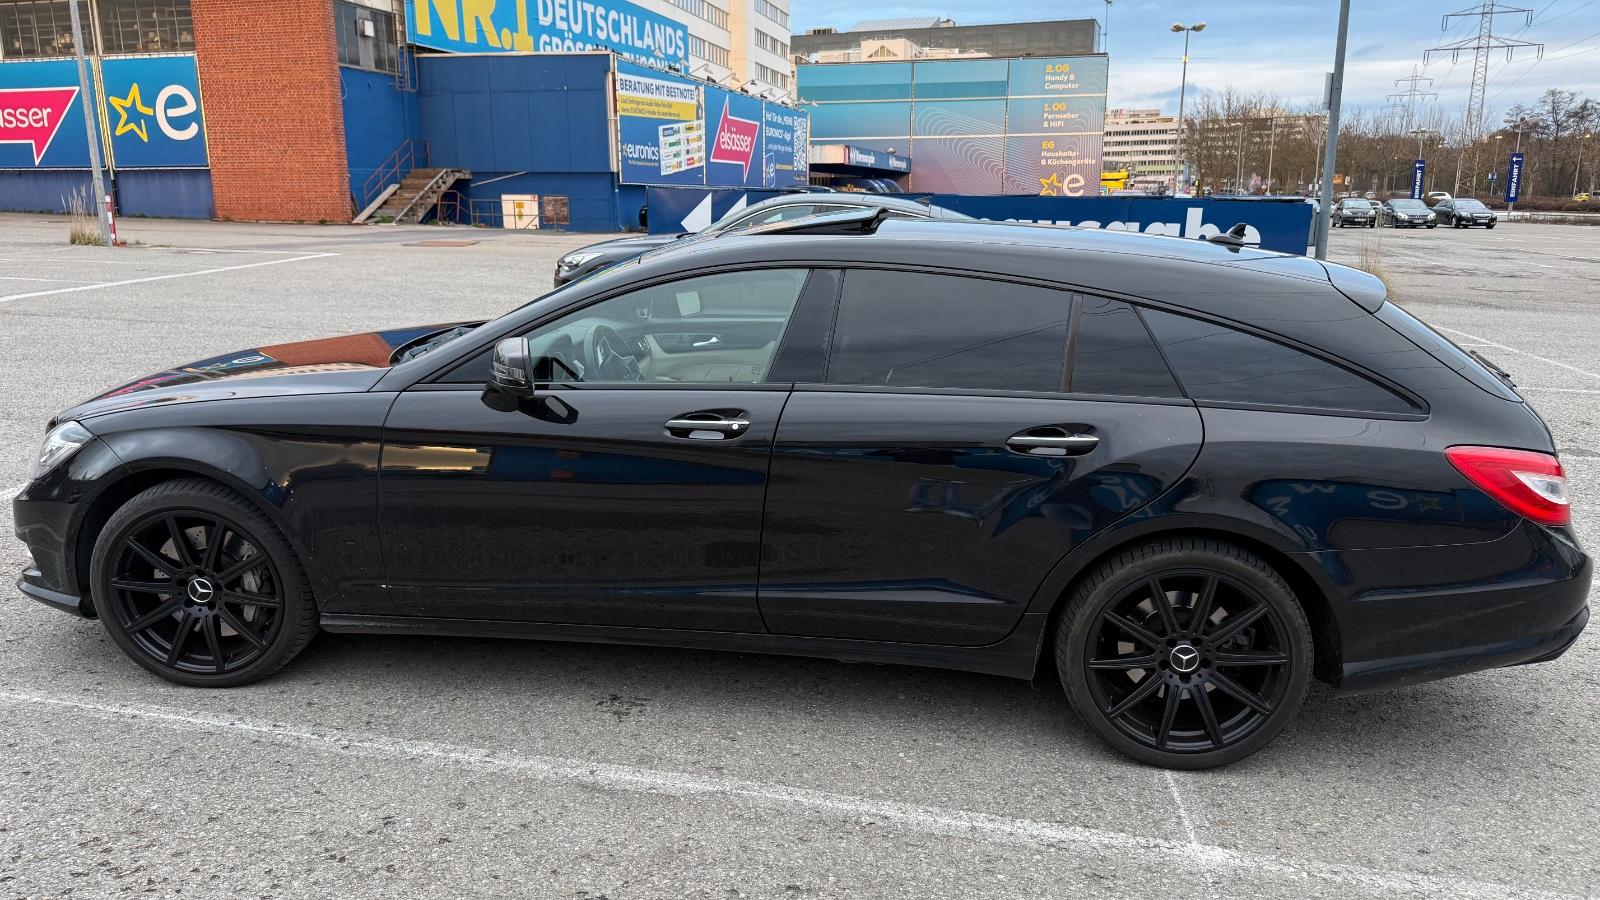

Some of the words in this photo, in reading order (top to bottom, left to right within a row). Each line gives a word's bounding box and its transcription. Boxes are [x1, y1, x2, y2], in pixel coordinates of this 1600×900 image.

[537, 0, 685, 58] DEUTSCHLANDS
[1055, 64, 1070, 73] OG
[1045, 74, 1068, 82] Handy
[620, 78, 654, 95] BERATUNG
[655, 83, 665, 96] MIT
[666, 85, 695, 100] BESTNOTE!
[1044, 83, 1079, 91] Computer
[1052, 103, 1067, 111] OG
[720, 123, 752, 152] elsässer
[627, 141, 659, 161] euronics
[1042, 141, 1055, 149] EG
[1048, 158, 1096, 167] Küchengeräte
[1413, 169, 1422, 199] EINFAHRT
[1509, 163, 1520, 198] EINFAHRT
